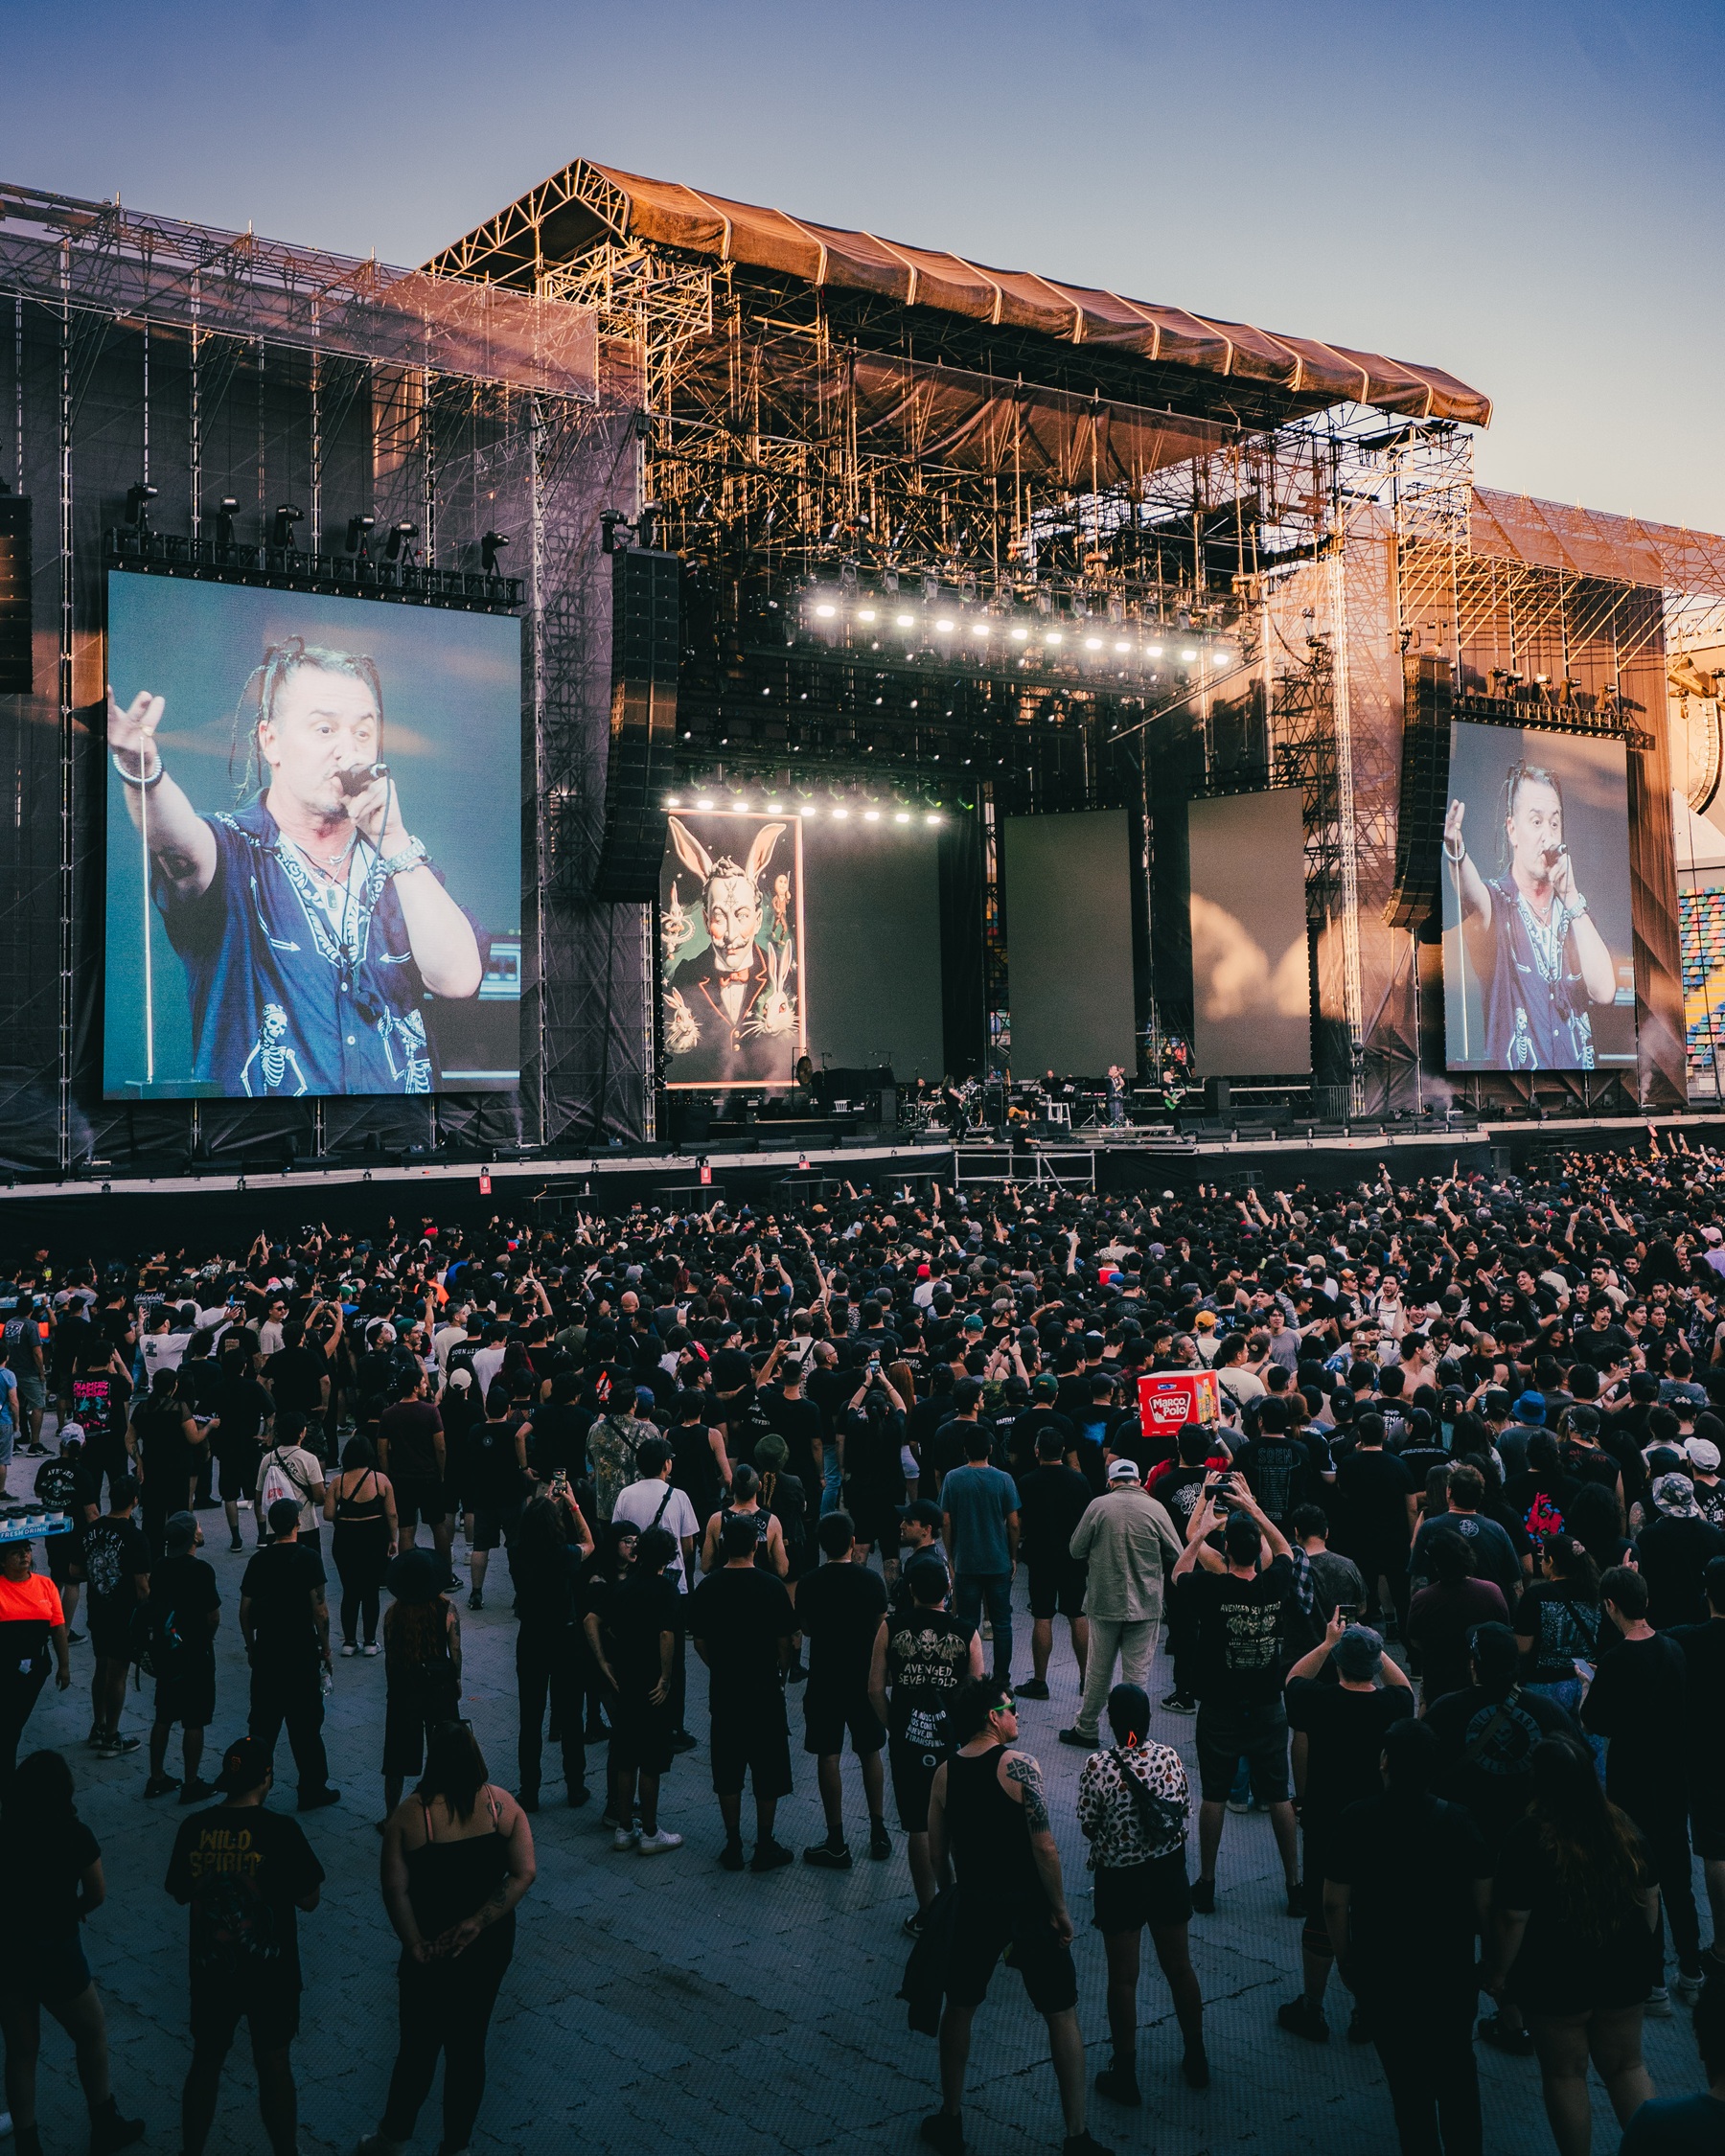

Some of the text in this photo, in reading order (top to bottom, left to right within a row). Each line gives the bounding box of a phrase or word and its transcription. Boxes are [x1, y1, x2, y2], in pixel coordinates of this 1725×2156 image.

[1162, 1405, 1186, 1417] Polo
[24, 1525, 47, 1535] DRINK
[904, 1663, 953, 1677] AVENGED
[1516, 1710, 1540, 1733] ART
[198, 1827, 253, 1851] WILD
[190, 1850, 263, 1878] SPIRIT
